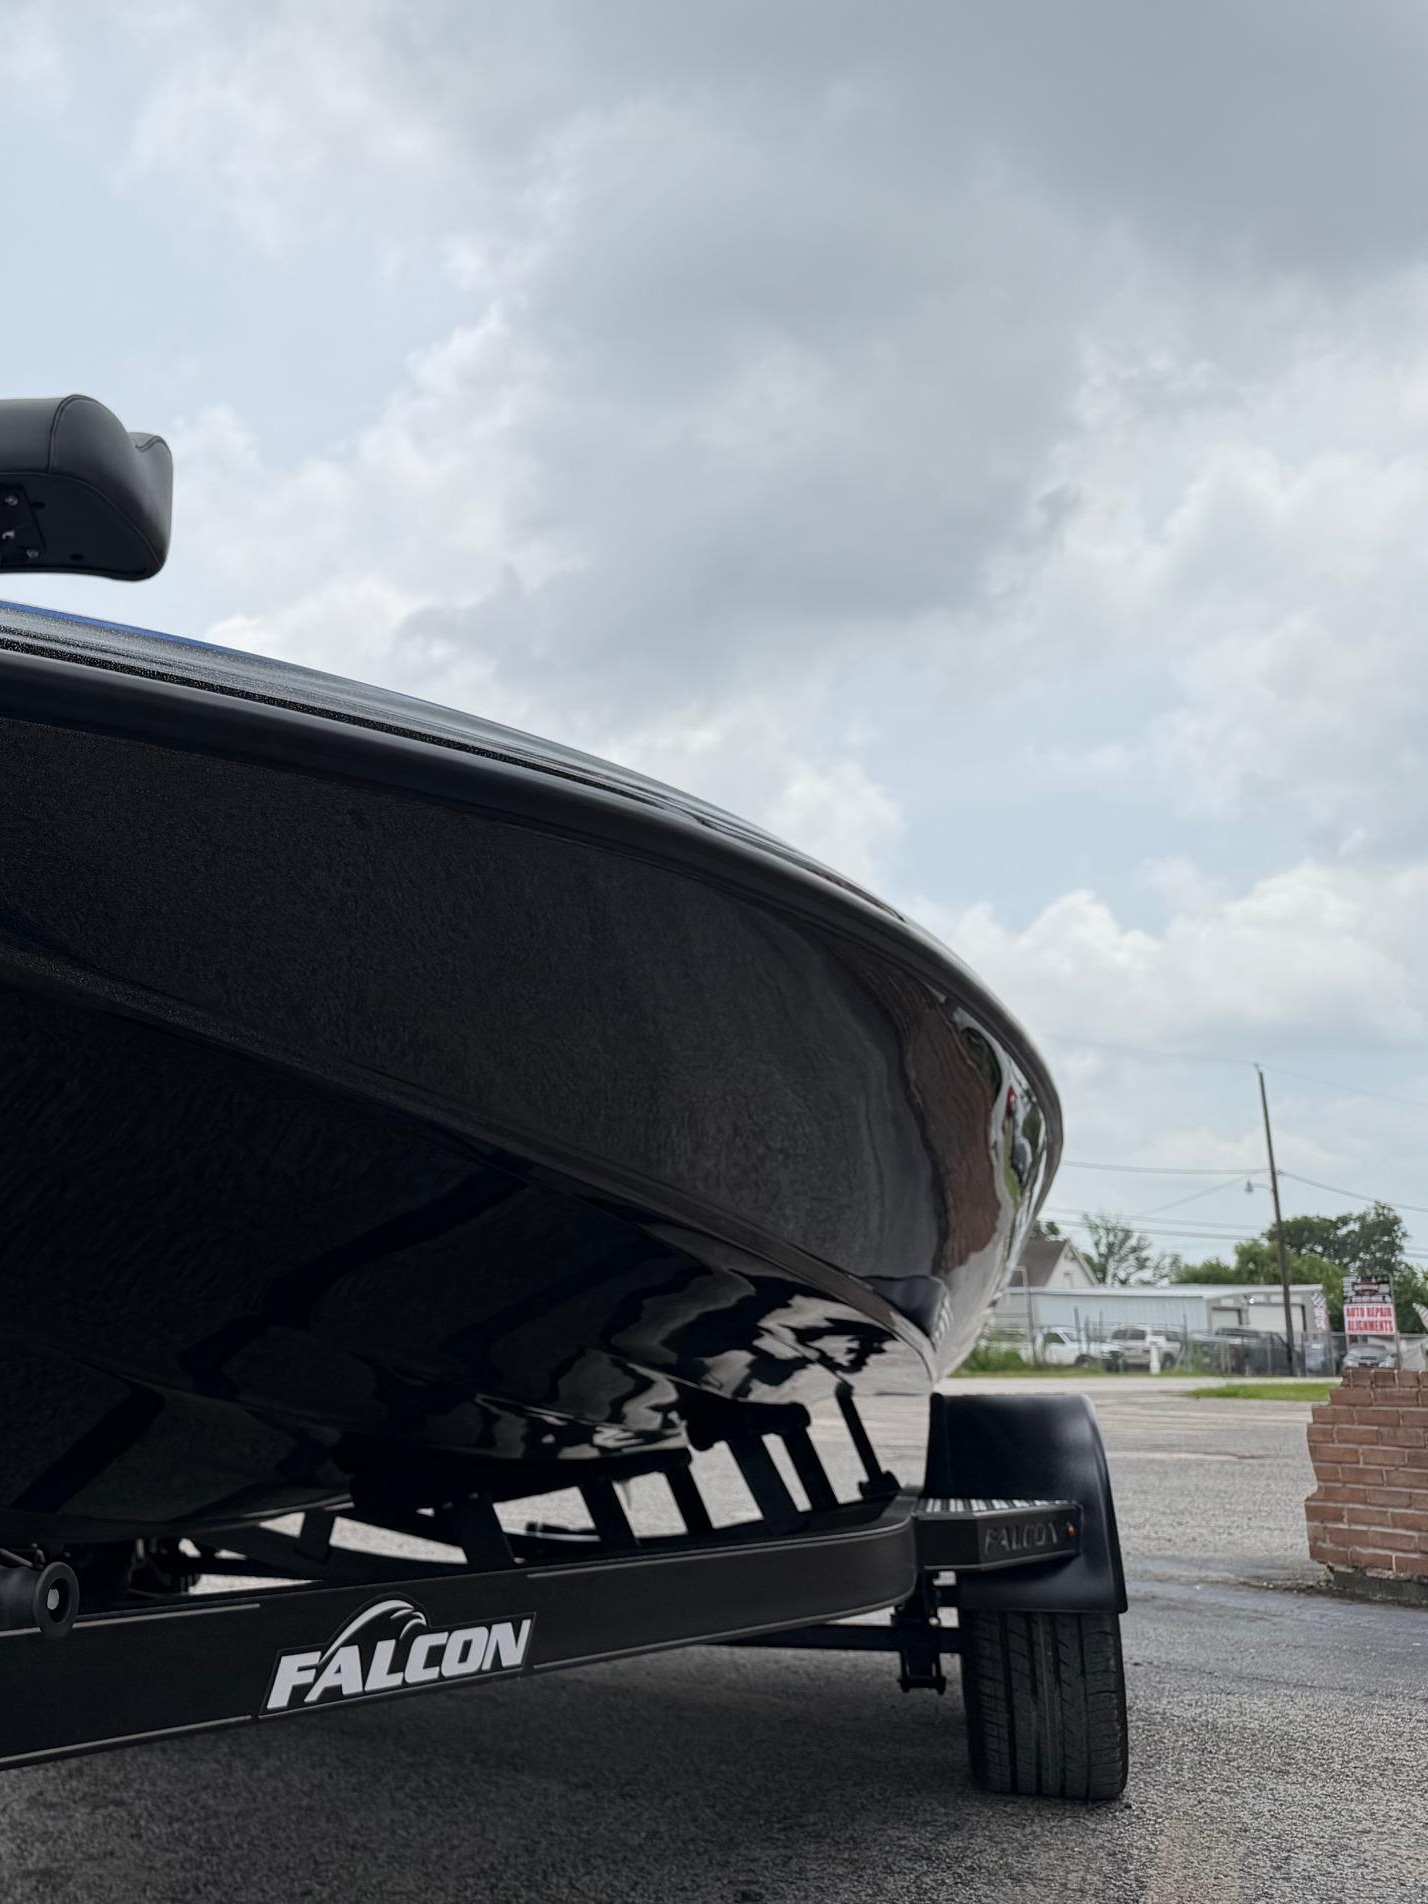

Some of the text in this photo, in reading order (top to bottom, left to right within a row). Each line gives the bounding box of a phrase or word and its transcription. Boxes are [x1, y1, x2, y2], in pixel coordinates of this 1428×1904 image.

[1347, 1307, 1392, 1317] AUTO REPAIR
[1348, 1320, 1393, 1331] ALIGNMENTS
[985, 1522, 1058, 1553] FALCON
[267, 1619, 531, 1710] FALCON
